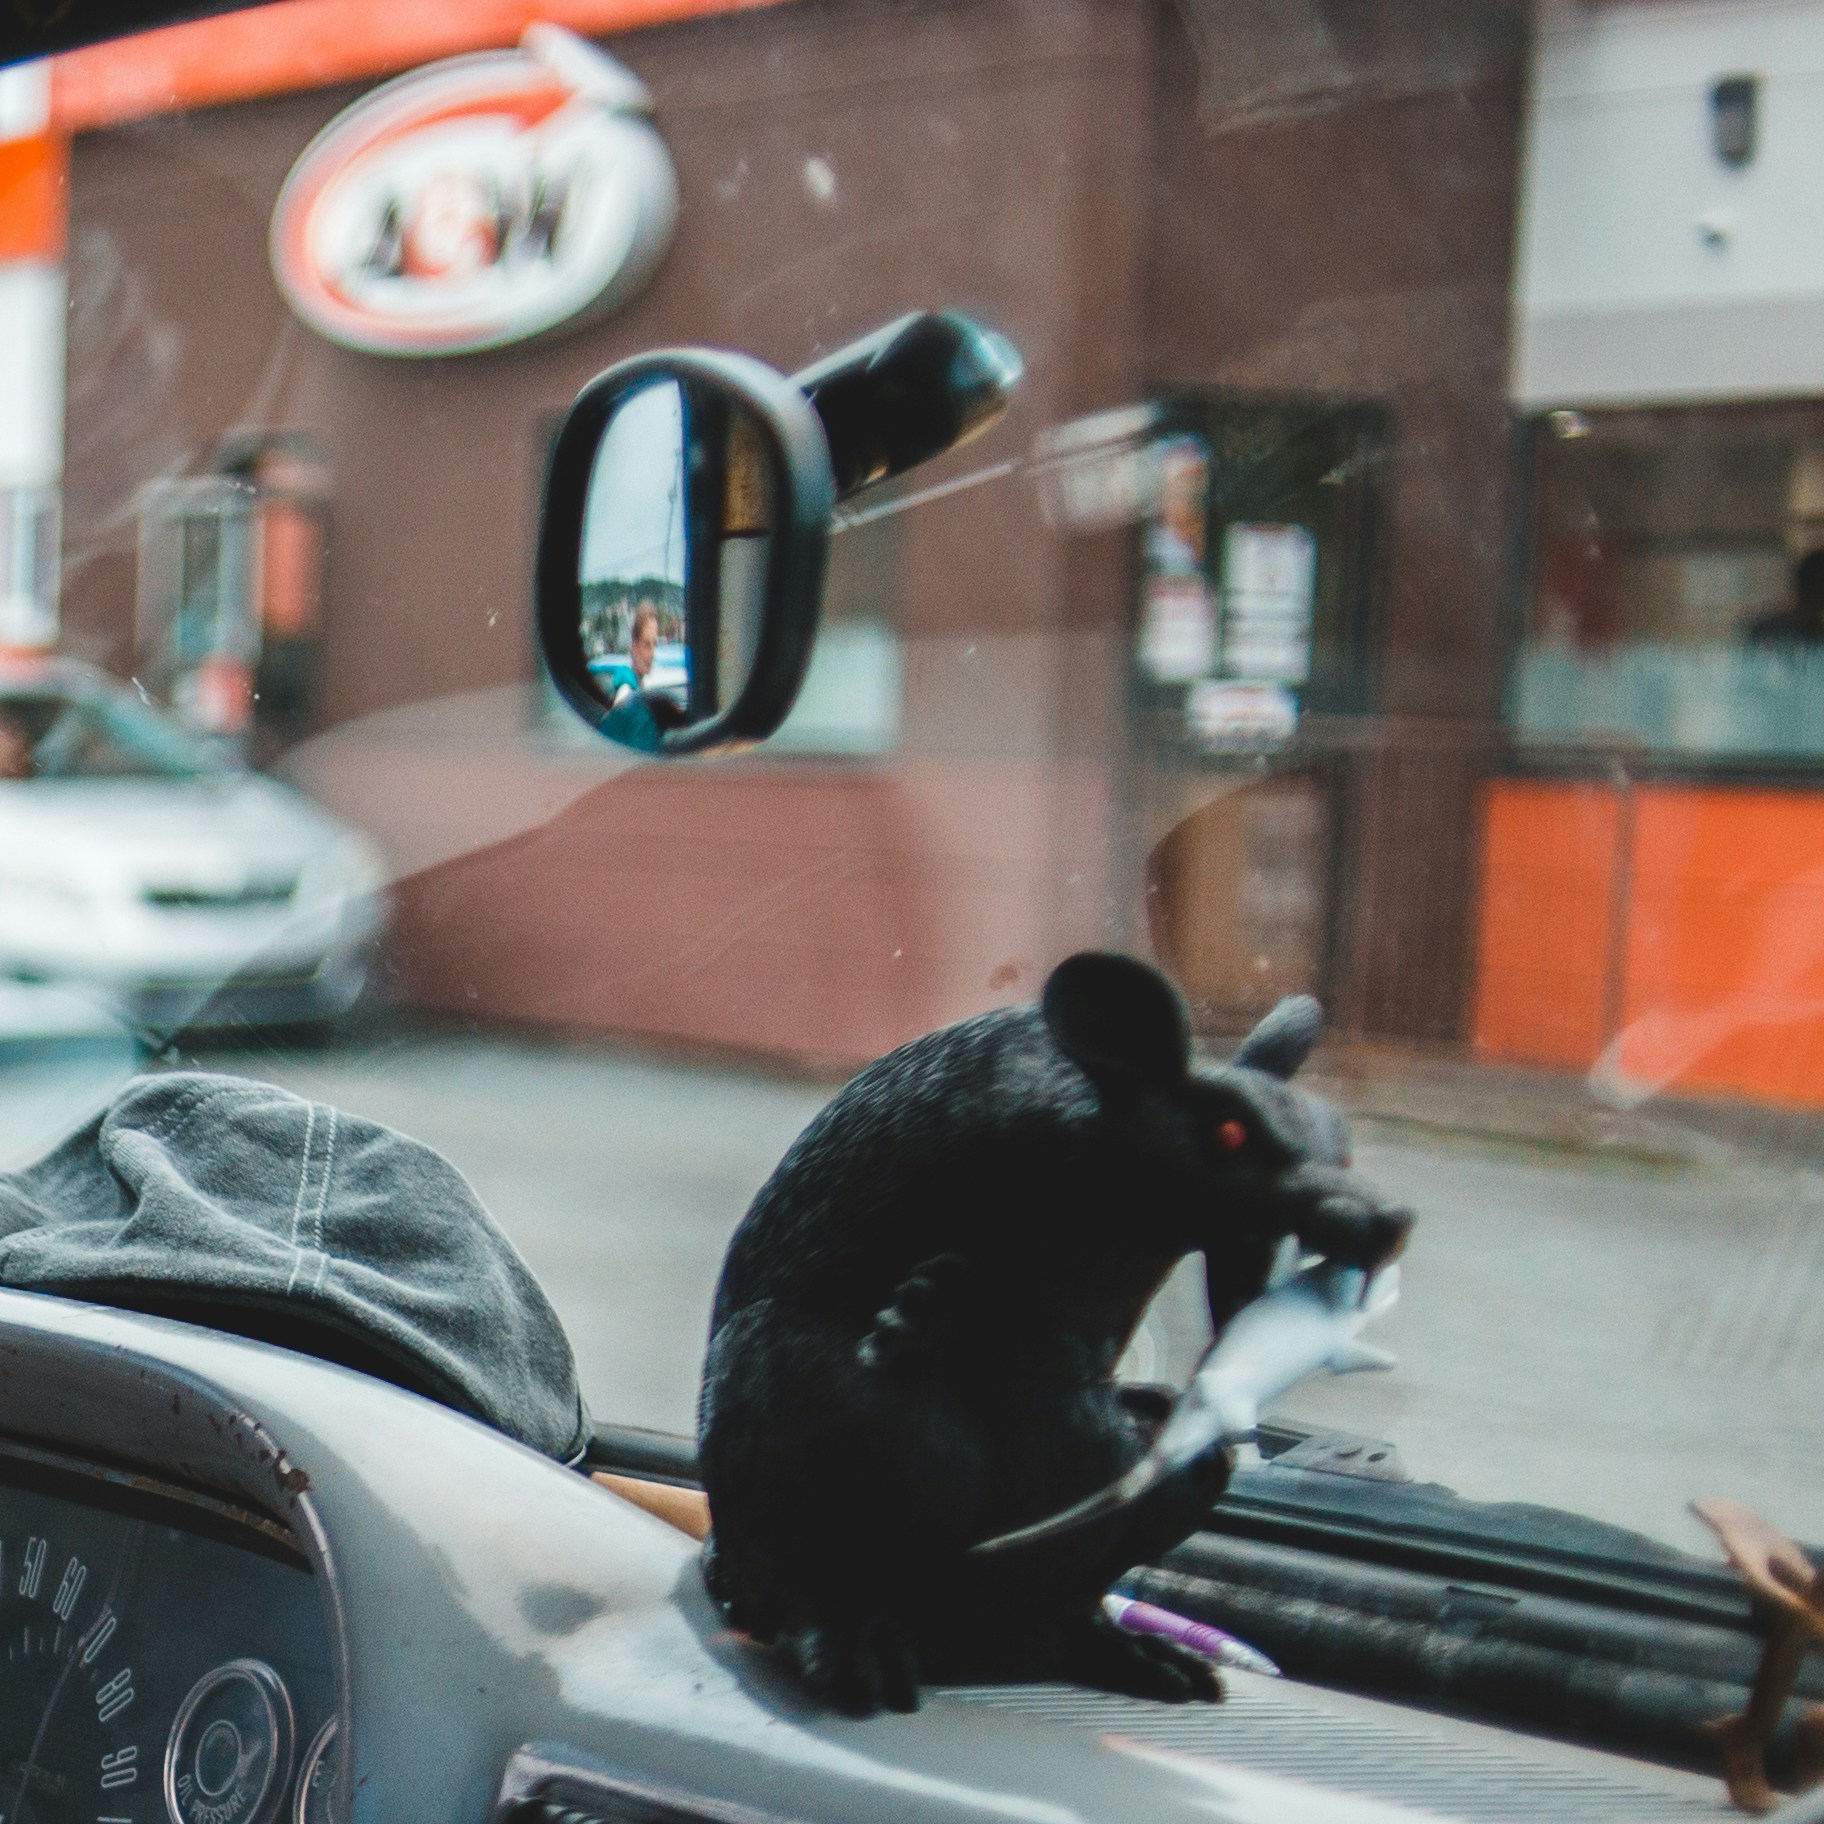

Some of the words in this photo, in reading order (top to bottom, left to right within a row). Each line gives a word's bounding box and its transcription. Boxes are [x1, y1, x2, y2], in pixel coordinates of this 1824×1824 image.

[18, 1536, 48, 1599] 50
[52, 1556, 88, 1622] 60
[95, 1667, 136, 1723] 80
[100, 1745, 139, 1789] 90
[176, 1773, 194, 1806] OIL
